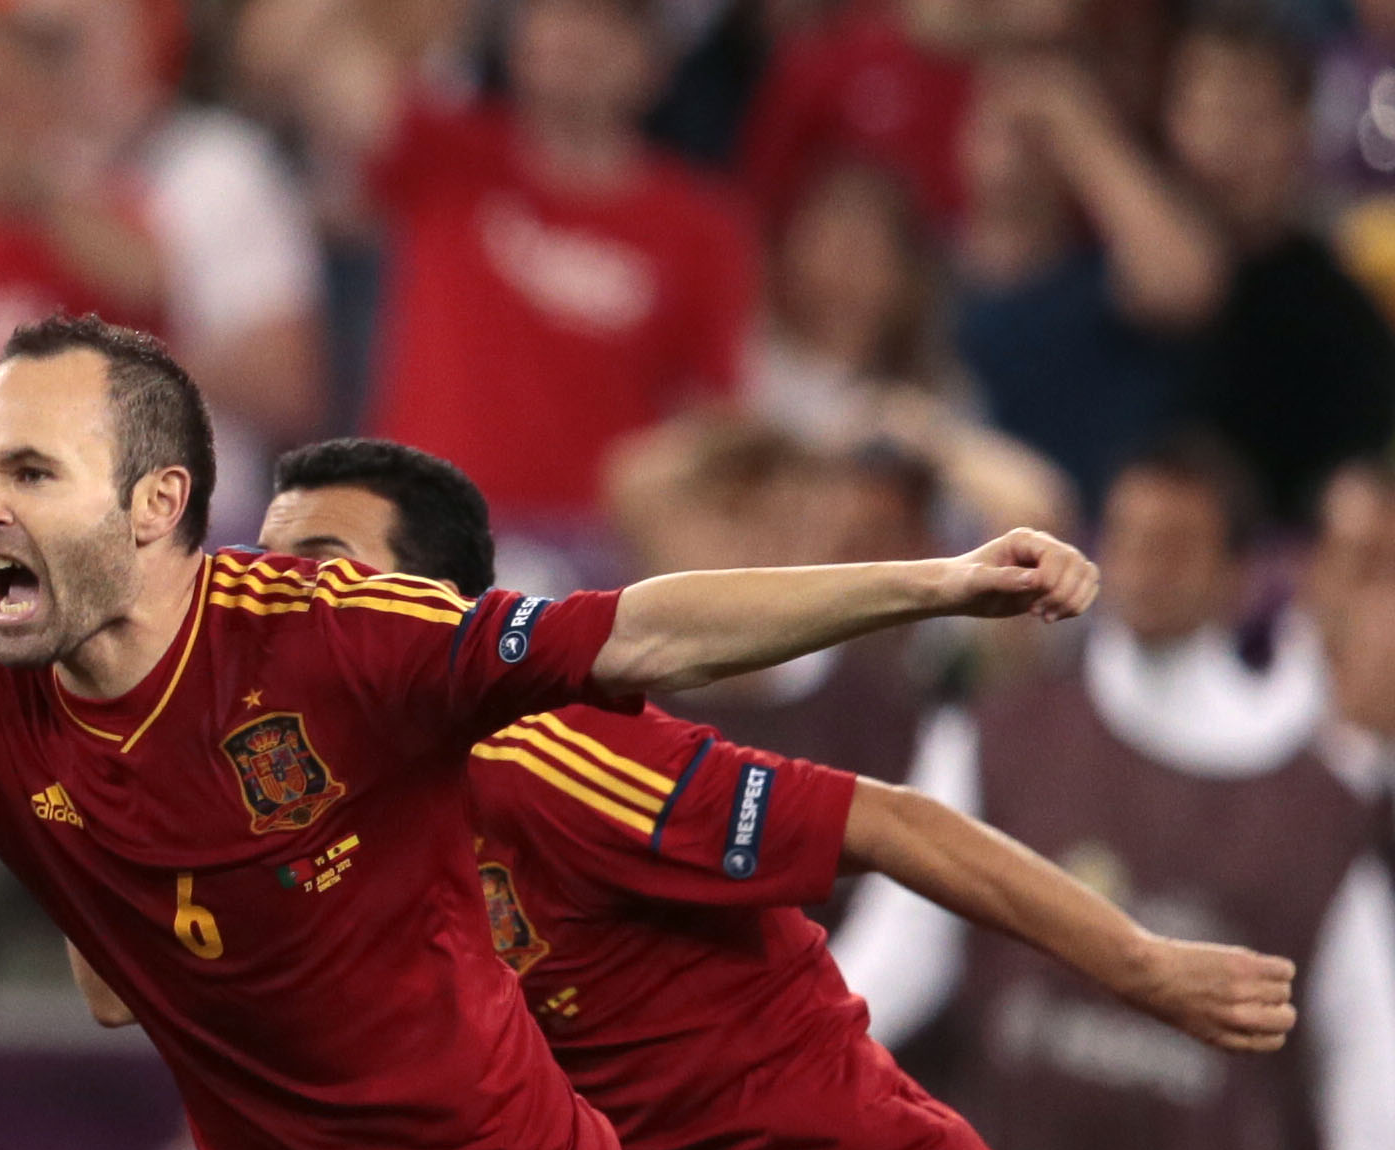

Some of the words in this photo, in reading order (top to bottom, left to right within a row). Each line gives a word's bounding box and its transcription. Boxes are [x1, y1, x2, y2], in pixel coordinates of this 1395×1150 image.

[32, 801, 84, 829] dida
[734, 767, 767, 846] RESPECT
[174, 874, 224, 960] 6
